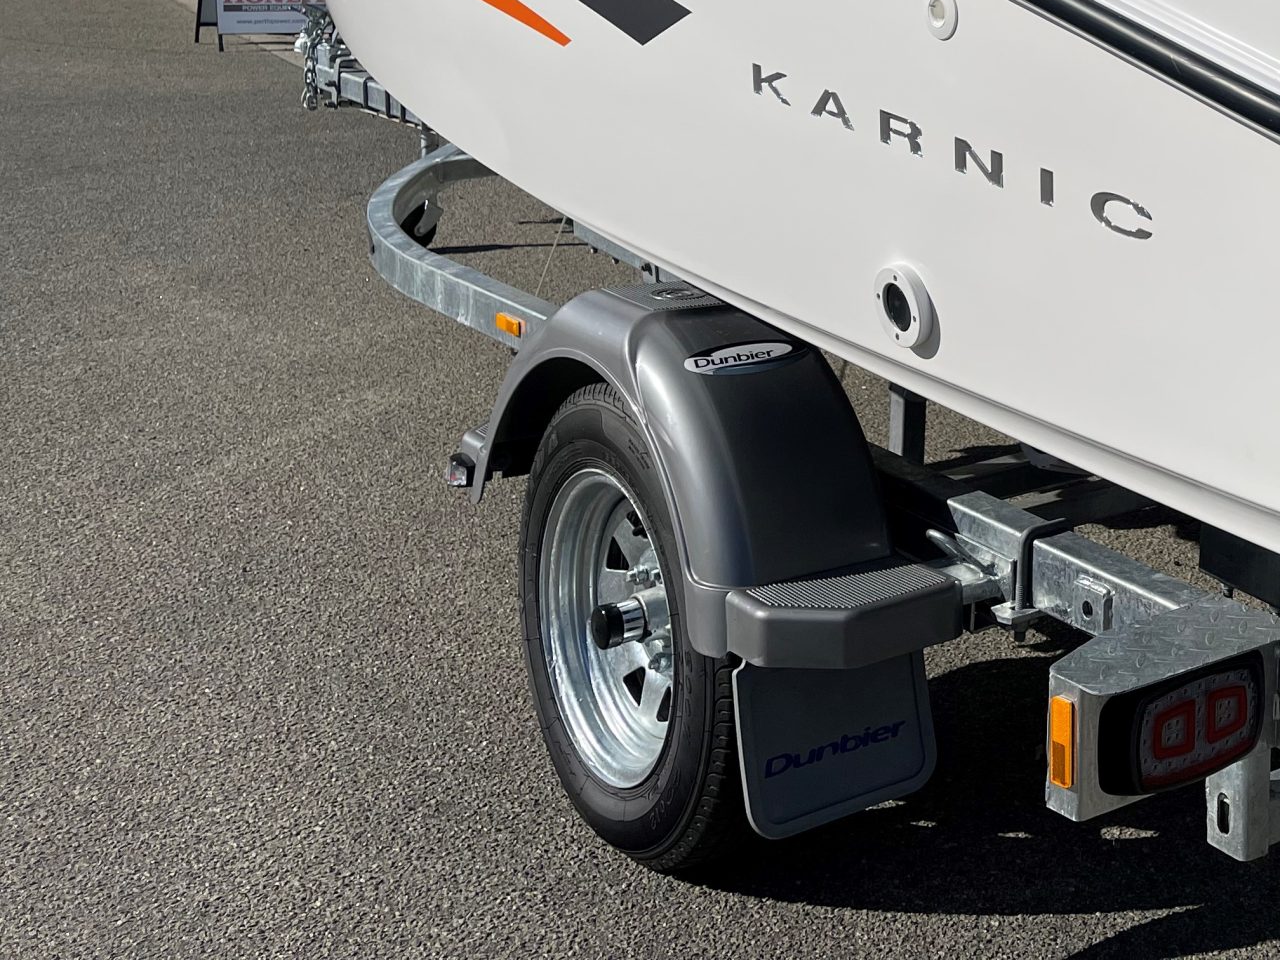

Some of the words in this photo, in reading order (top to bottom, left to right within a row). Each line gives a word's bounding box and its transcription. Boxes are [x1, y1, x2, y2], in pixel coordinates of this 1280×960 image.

[751, 63, 1153, 240] KARNIC
[693, 349, 775, 369] Dunbier
[764, 720, 906, 779] Dunbier
